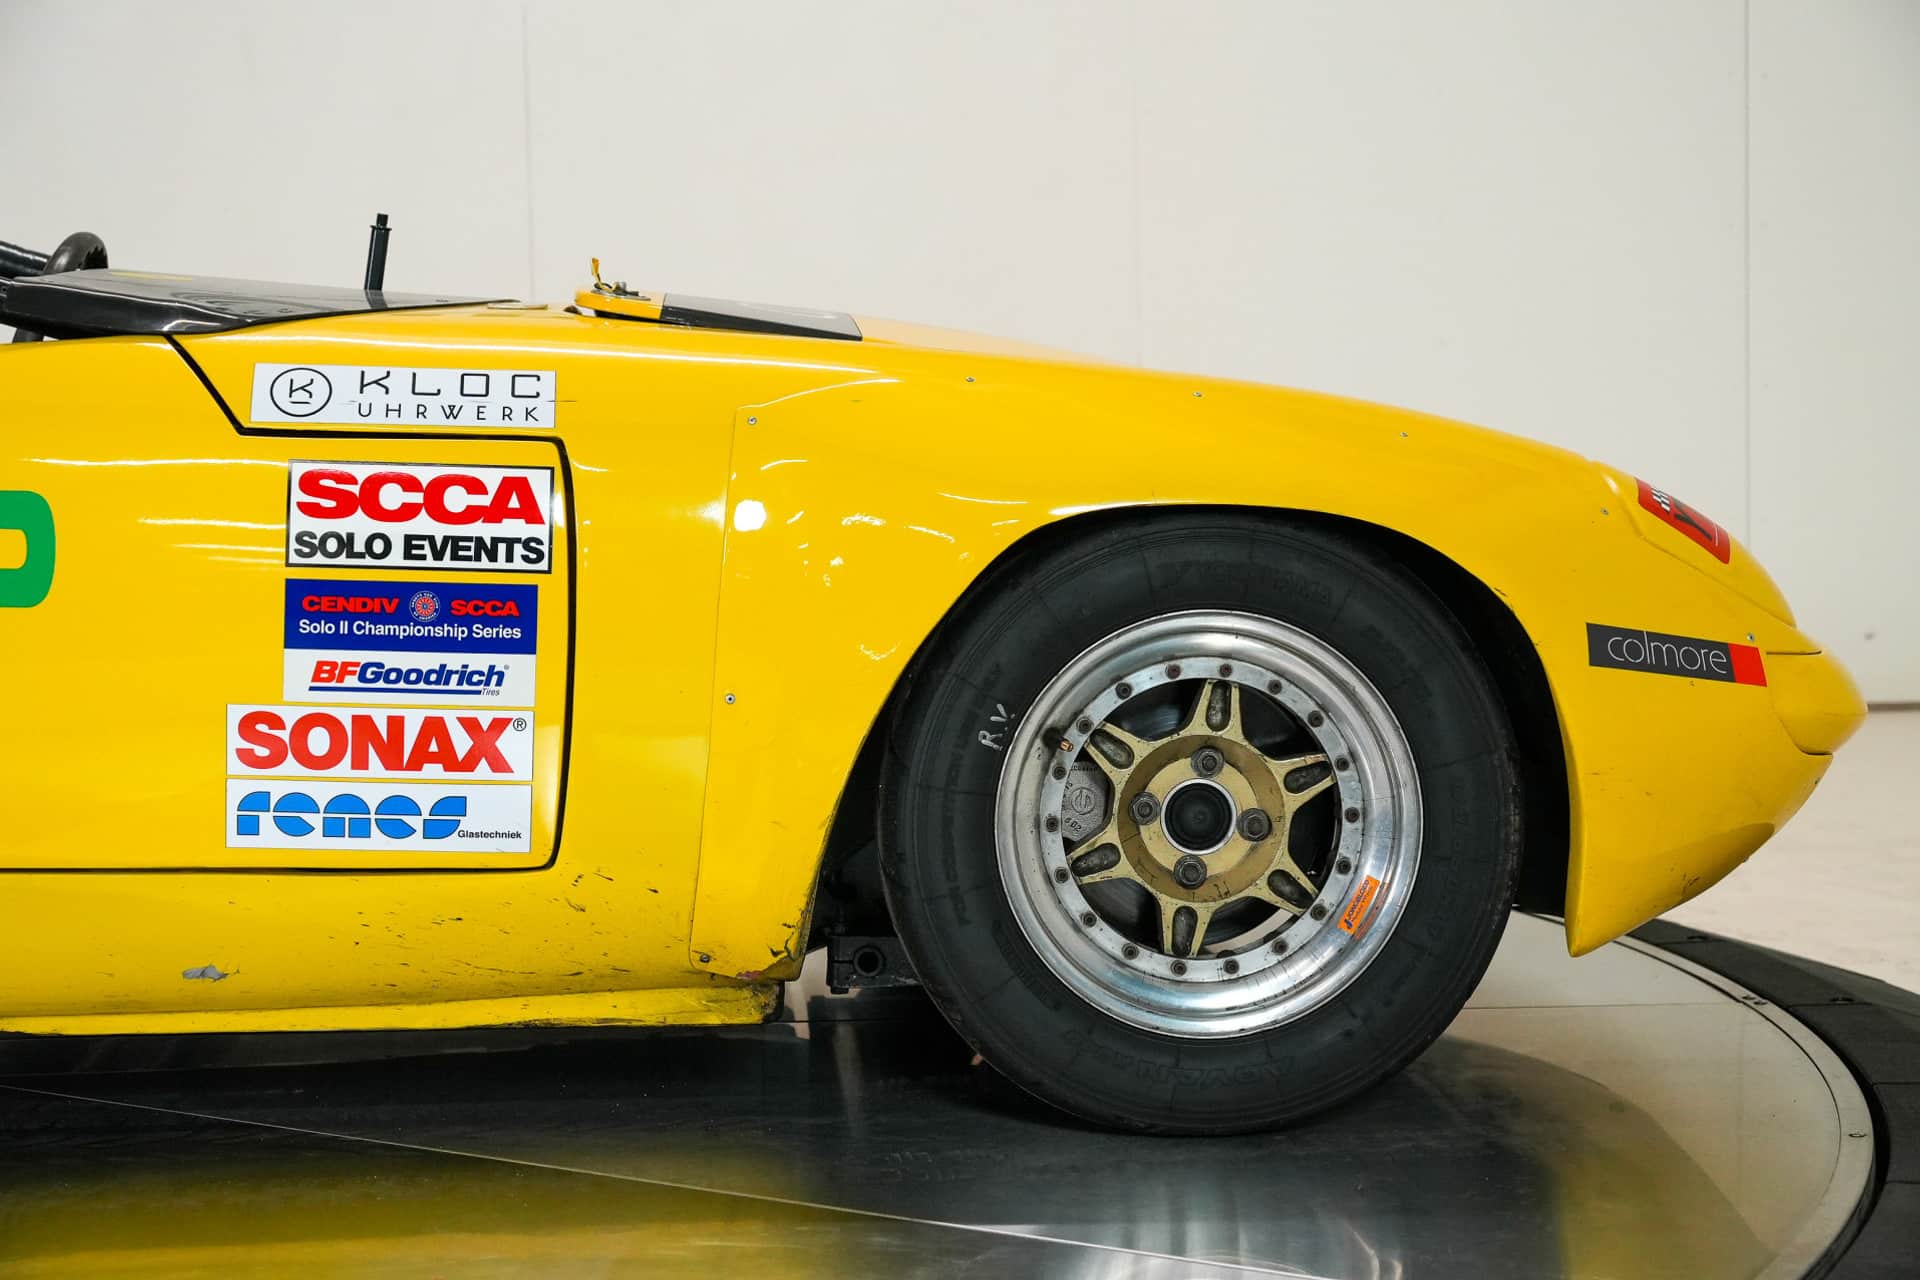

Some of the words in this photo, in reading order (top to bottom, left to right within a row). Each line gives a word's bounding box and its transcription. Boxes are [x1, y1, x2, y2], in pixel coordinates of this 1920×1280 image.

[360, 370, 541, 399] KLOC
[358, 402, 540, 422] UHRWERK
[296, 469, 546, 526] SCCA
[294, 531, 393, 561] SOLO
[403, 535, 546, 565] EVENTS
[302, 595, 400, 614] CENDIV
[450, 600, 520, 617] SCCA
[299, 619, 335, 635] Solo
[339, 620, 348, 635] II
[353, 620, 468, 640] Championship
[472, 624, 521, 639] Series
[1607, 630, 1728, 674] colmore
[481, 688, 500, 697] Tires
[237, 791, 467, 840] renes
[457, 829, 522, 840] Glastechniek
